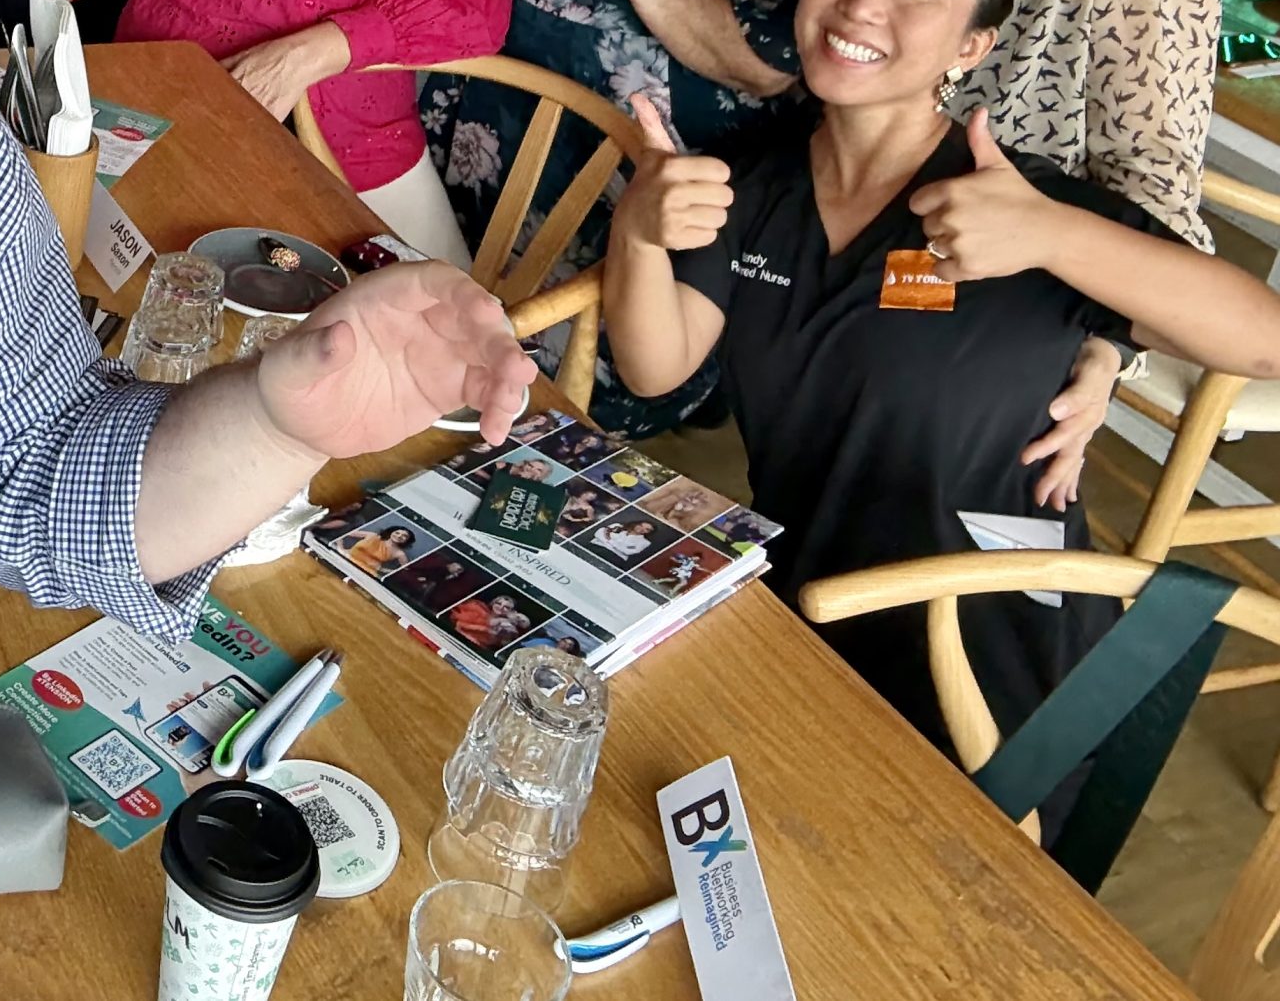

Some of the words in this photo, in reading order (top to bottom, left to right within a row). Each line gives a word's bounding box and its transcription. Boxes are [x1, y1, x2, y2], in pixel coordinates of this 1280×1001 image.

[110, 219, 142, 258] JASON
[111, 242, 130, 269] Saxon
[759, 269, 791, 287] Nurse
[507, 547, 571, 586] INSPIRED
[195, 612, 255, 662] kedIn?
[201, 601, 226, 624] VE
[224, 616, 272, 657] YOU
[13, 682, 39, 706] Create
[37, 703, 59, 724] More
[319, 773, 346, 789] TABLE
[345, 785, 358, 796] TO
[357, 794, 379, 818] ORDER
[374, 817, 386, 829] TO
[376, 829, 386, 851] SCAN
[709, 867, 736, 941] Networking
[720, 860, 743, 918] Business
[698, 872, 728, 952] Reimagined
